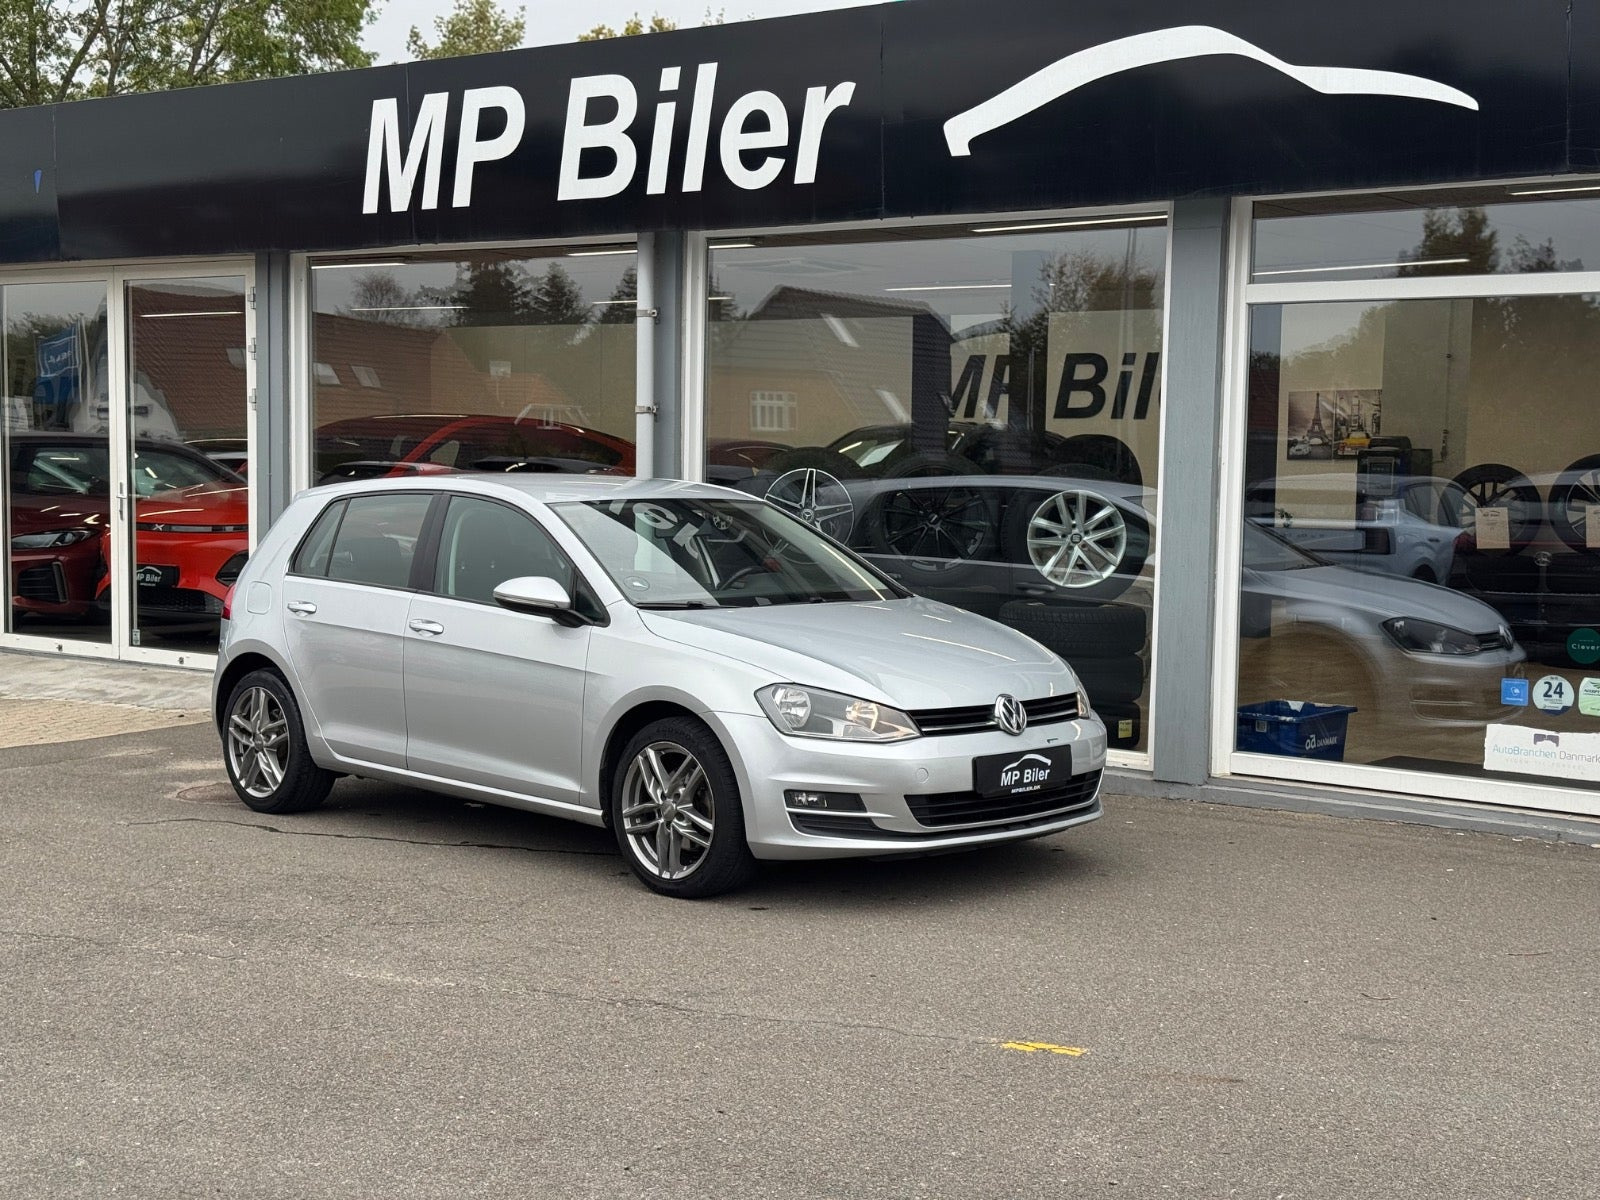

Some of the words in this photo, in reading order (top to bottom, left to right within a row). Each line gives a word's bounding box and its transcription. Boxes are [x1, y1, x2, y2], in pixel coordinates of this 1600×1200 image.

[363, 86, 525, 214] MP
[558, 62, 856, 200] Biler
[1053, 352, 1162, 419] Bil
[1543, 681, 1564, 699] 24
[1492, 744, 1557, 759] AutoBranchen
[1559, 750, 1600, 764] Danmark
[1001, 771, 1020, 786] MP
[1024, 768, 1050, 783] Biler
